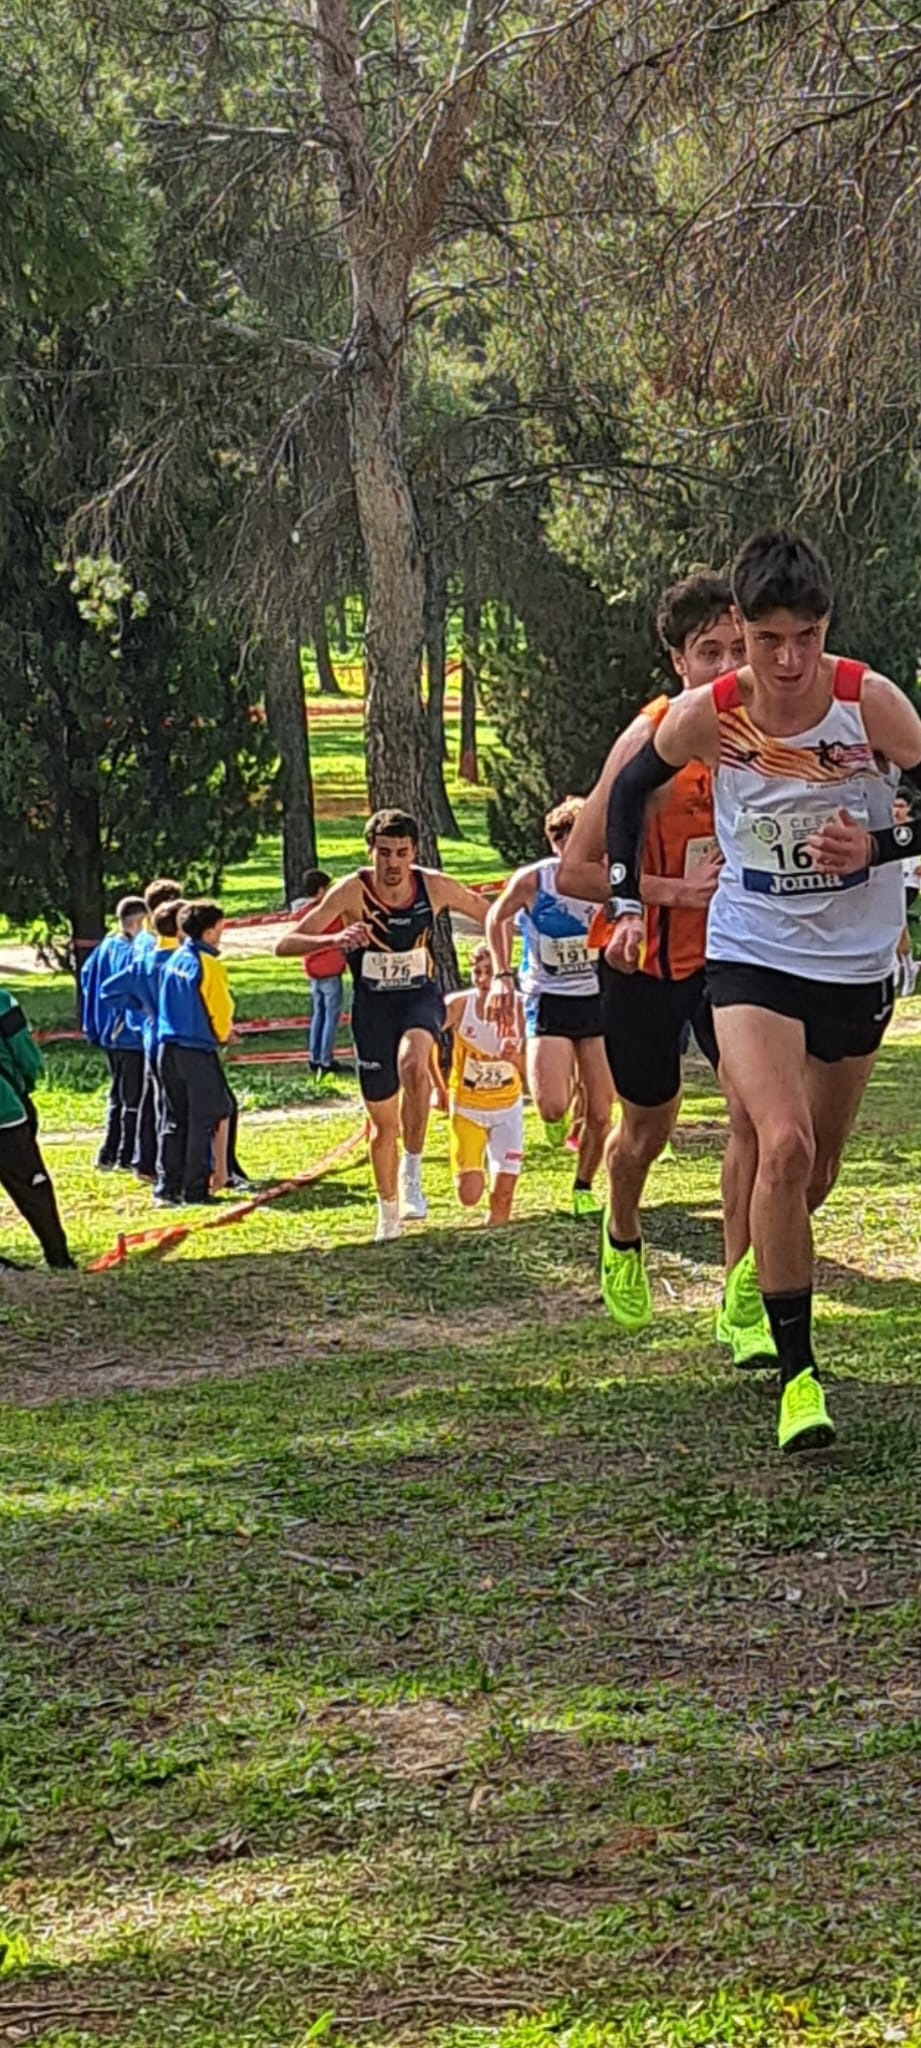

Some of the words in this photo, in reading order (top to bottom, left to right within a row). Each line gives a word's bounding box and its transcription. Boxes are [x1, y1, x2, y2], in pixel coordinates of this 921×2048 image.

[770, 842, 813, 870] 16
[769, 873, 843, 894] Joma
[557, 949, 588, 964] 191
